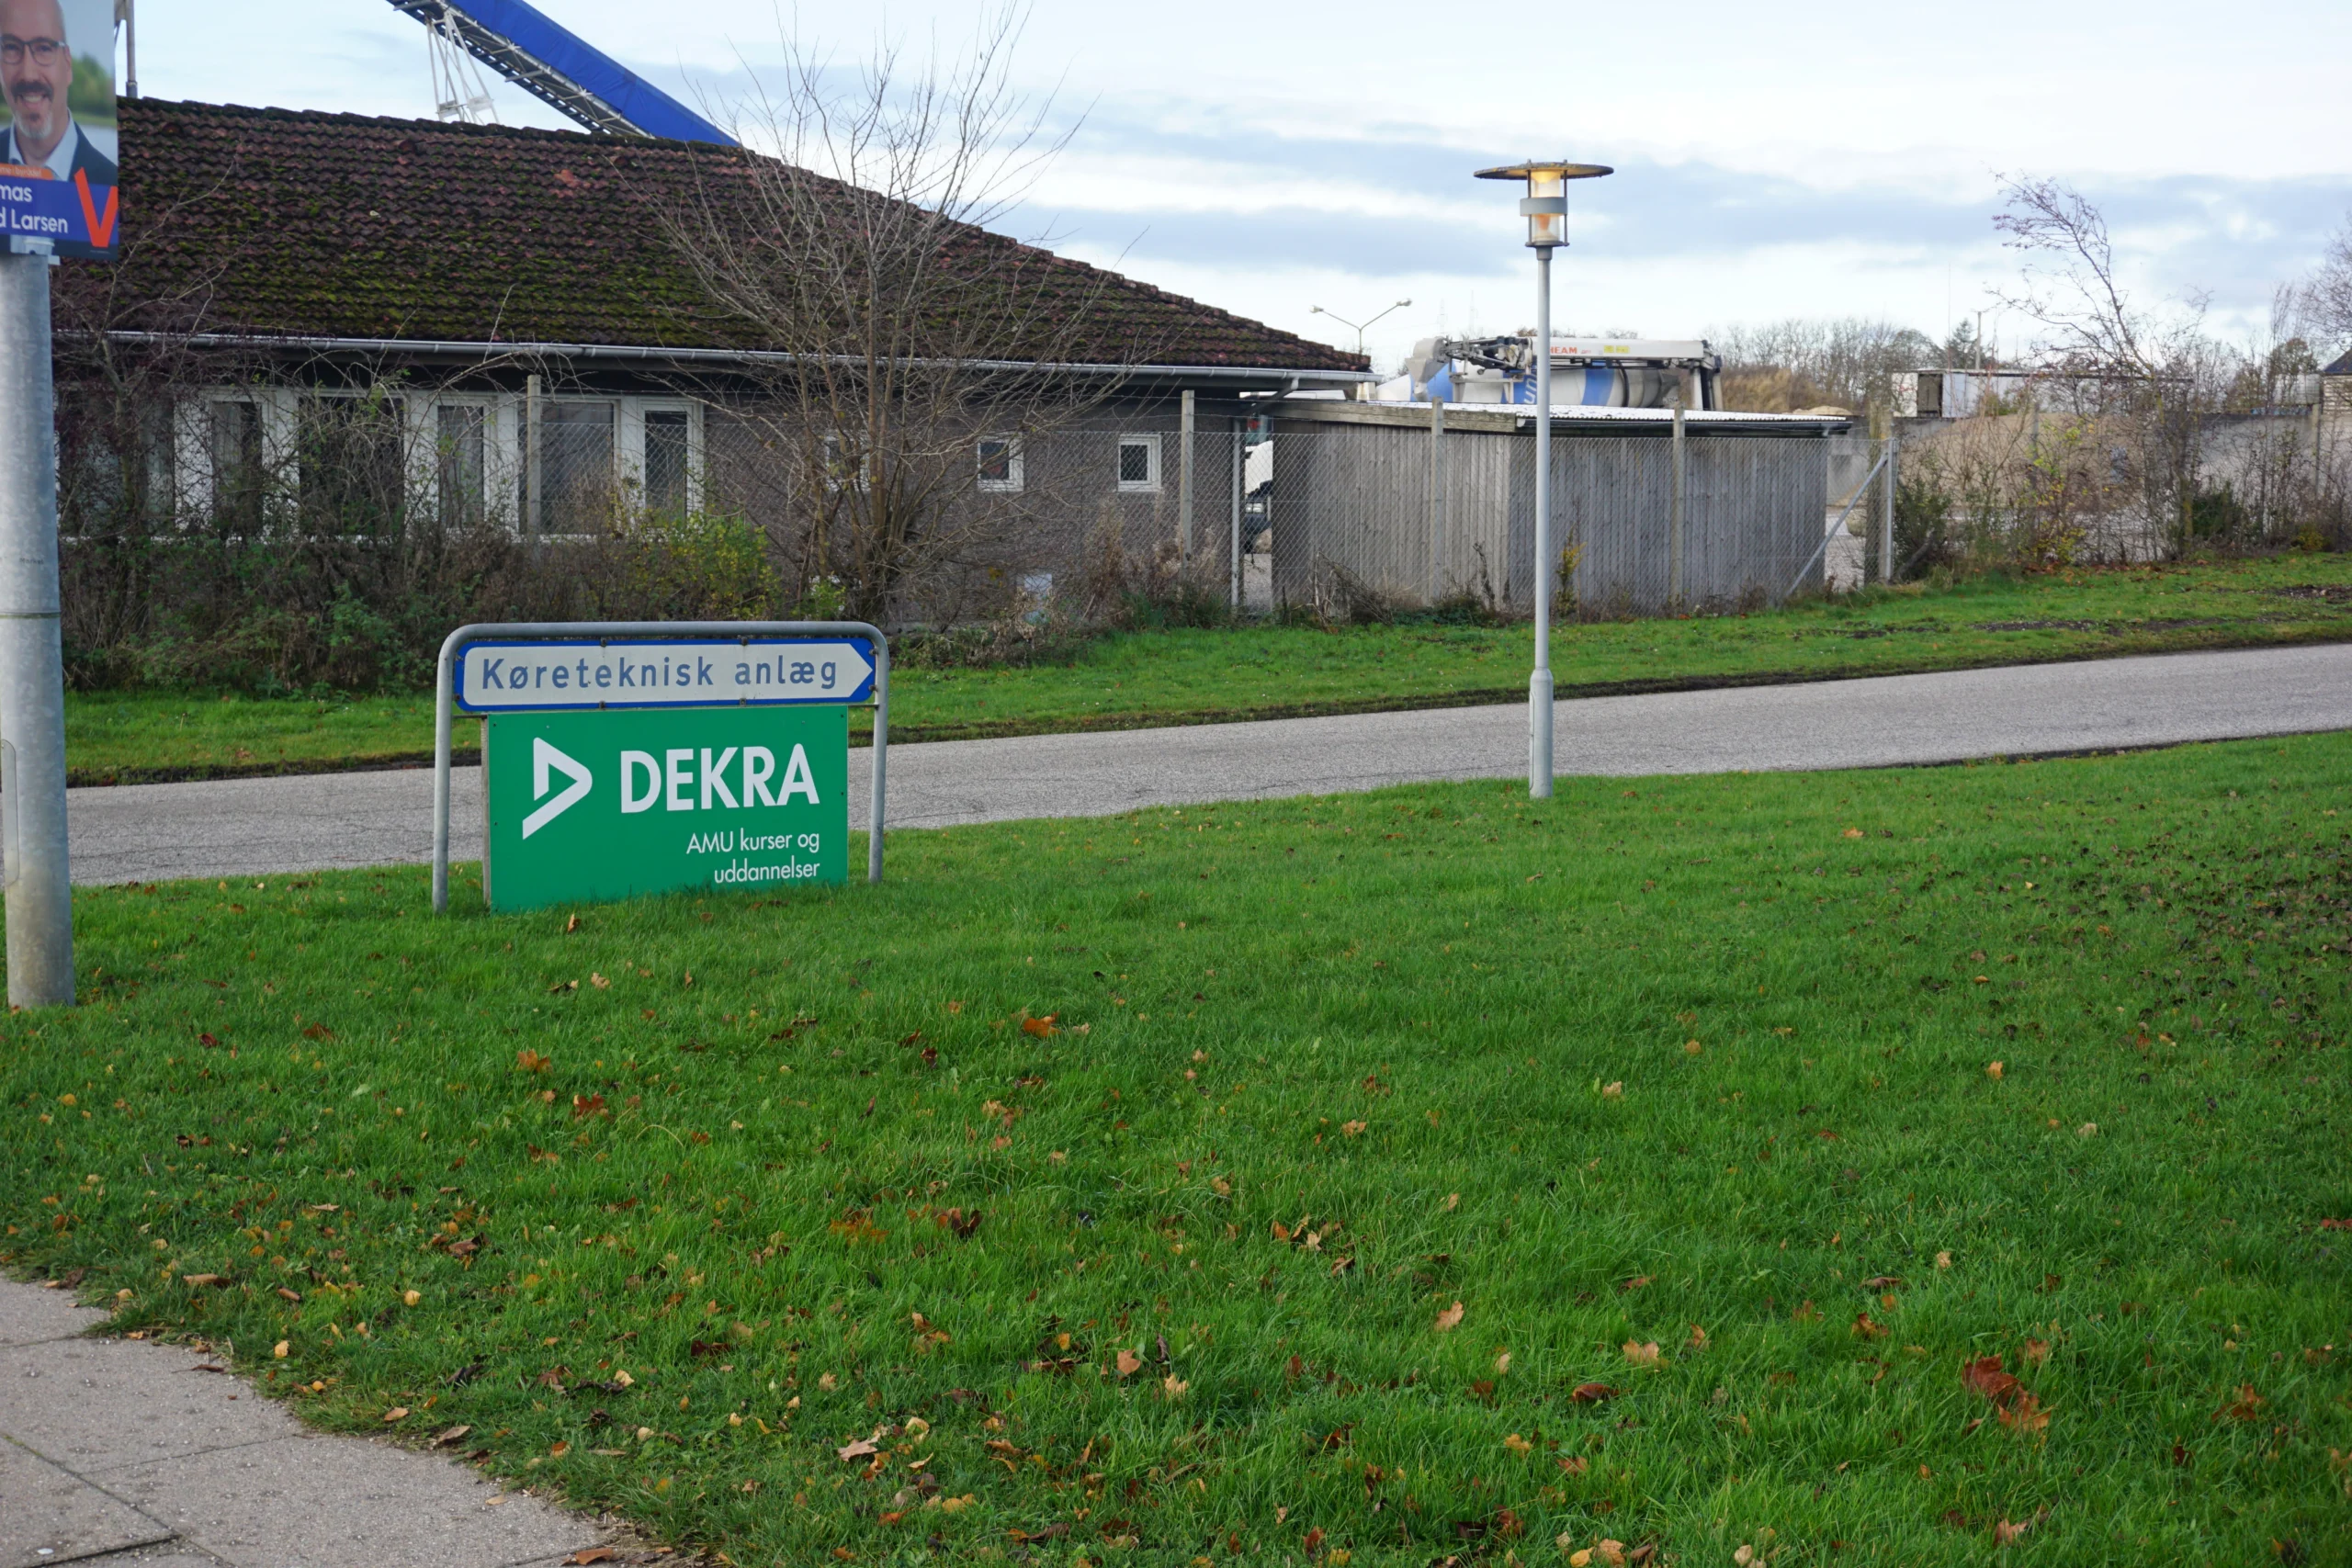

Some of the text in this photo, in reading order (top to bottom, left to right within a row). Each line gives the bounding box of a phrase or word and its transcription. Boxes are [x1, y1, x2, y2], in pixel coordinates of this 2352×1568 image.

[0, 185, 32, 202] mas
[11, 209, 69, 233] Larsen
[482, 655, 836, 689] Køreteknisk anlæg
[620, 743, 820, 814] DEKRA
[686, 828, 820, 854] AMU kurser og
[714, 855, 820, 885] uddannelser
